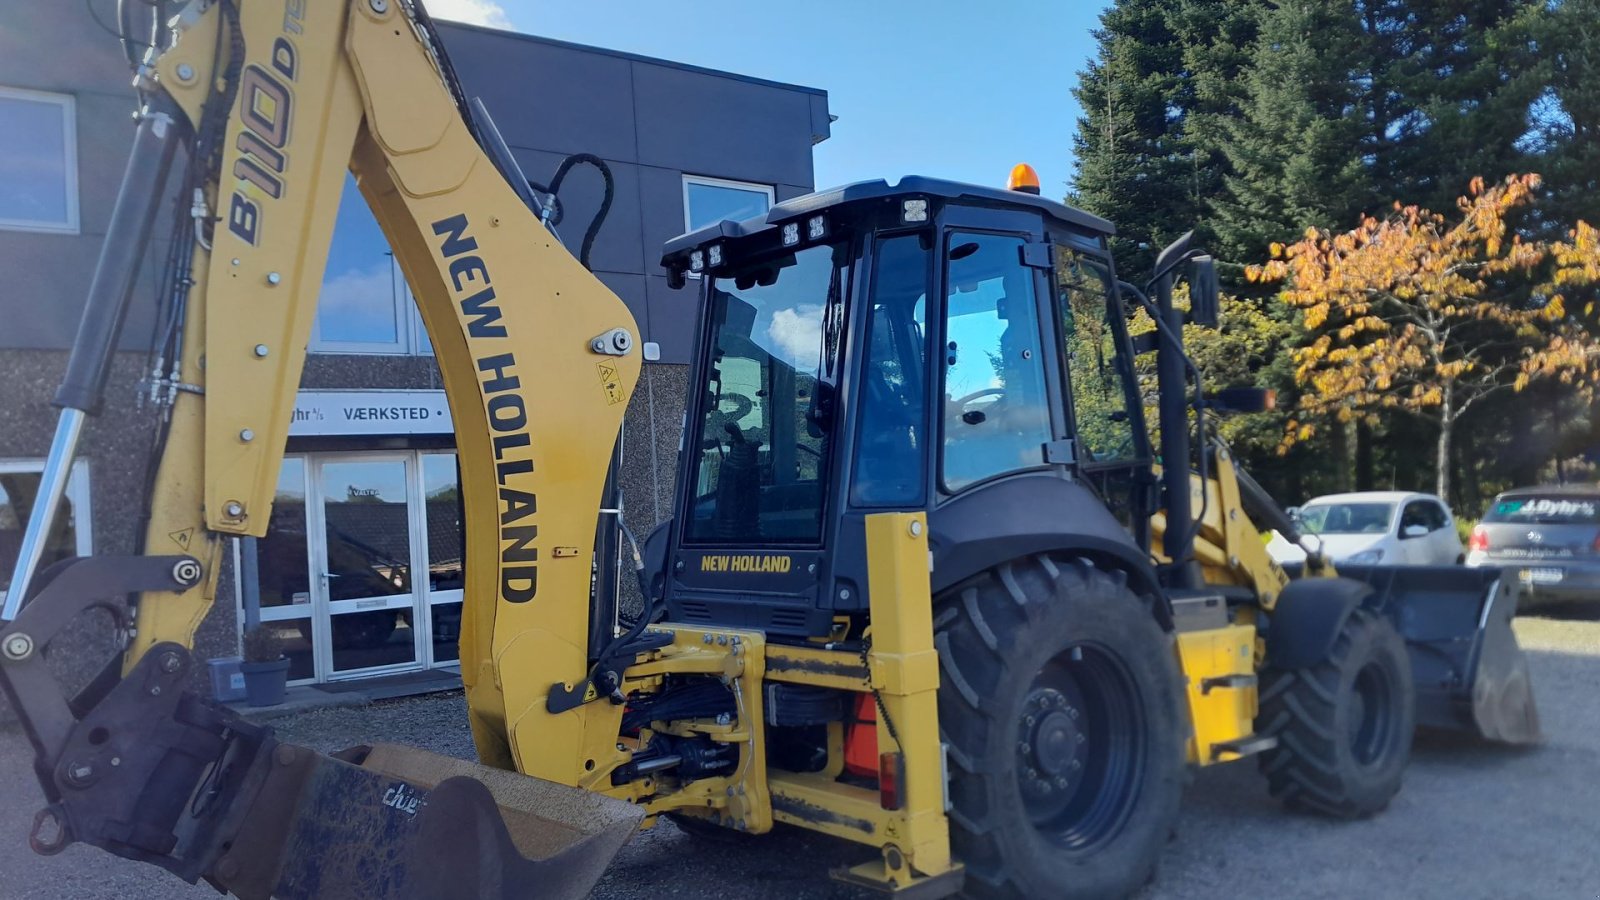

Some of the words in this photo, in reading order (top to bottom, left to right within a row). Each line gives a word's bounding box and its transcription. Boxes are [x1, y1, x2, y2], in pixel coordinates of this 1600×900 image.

[344, 407, 429, 420] VÆRKSTED
[431, 213, 508, 338] NEW
[477, 352, 538, 604] HOLLAND
[701, 555, 729, 572] NEW
[731, 555, 791, 573] HOLLAND
